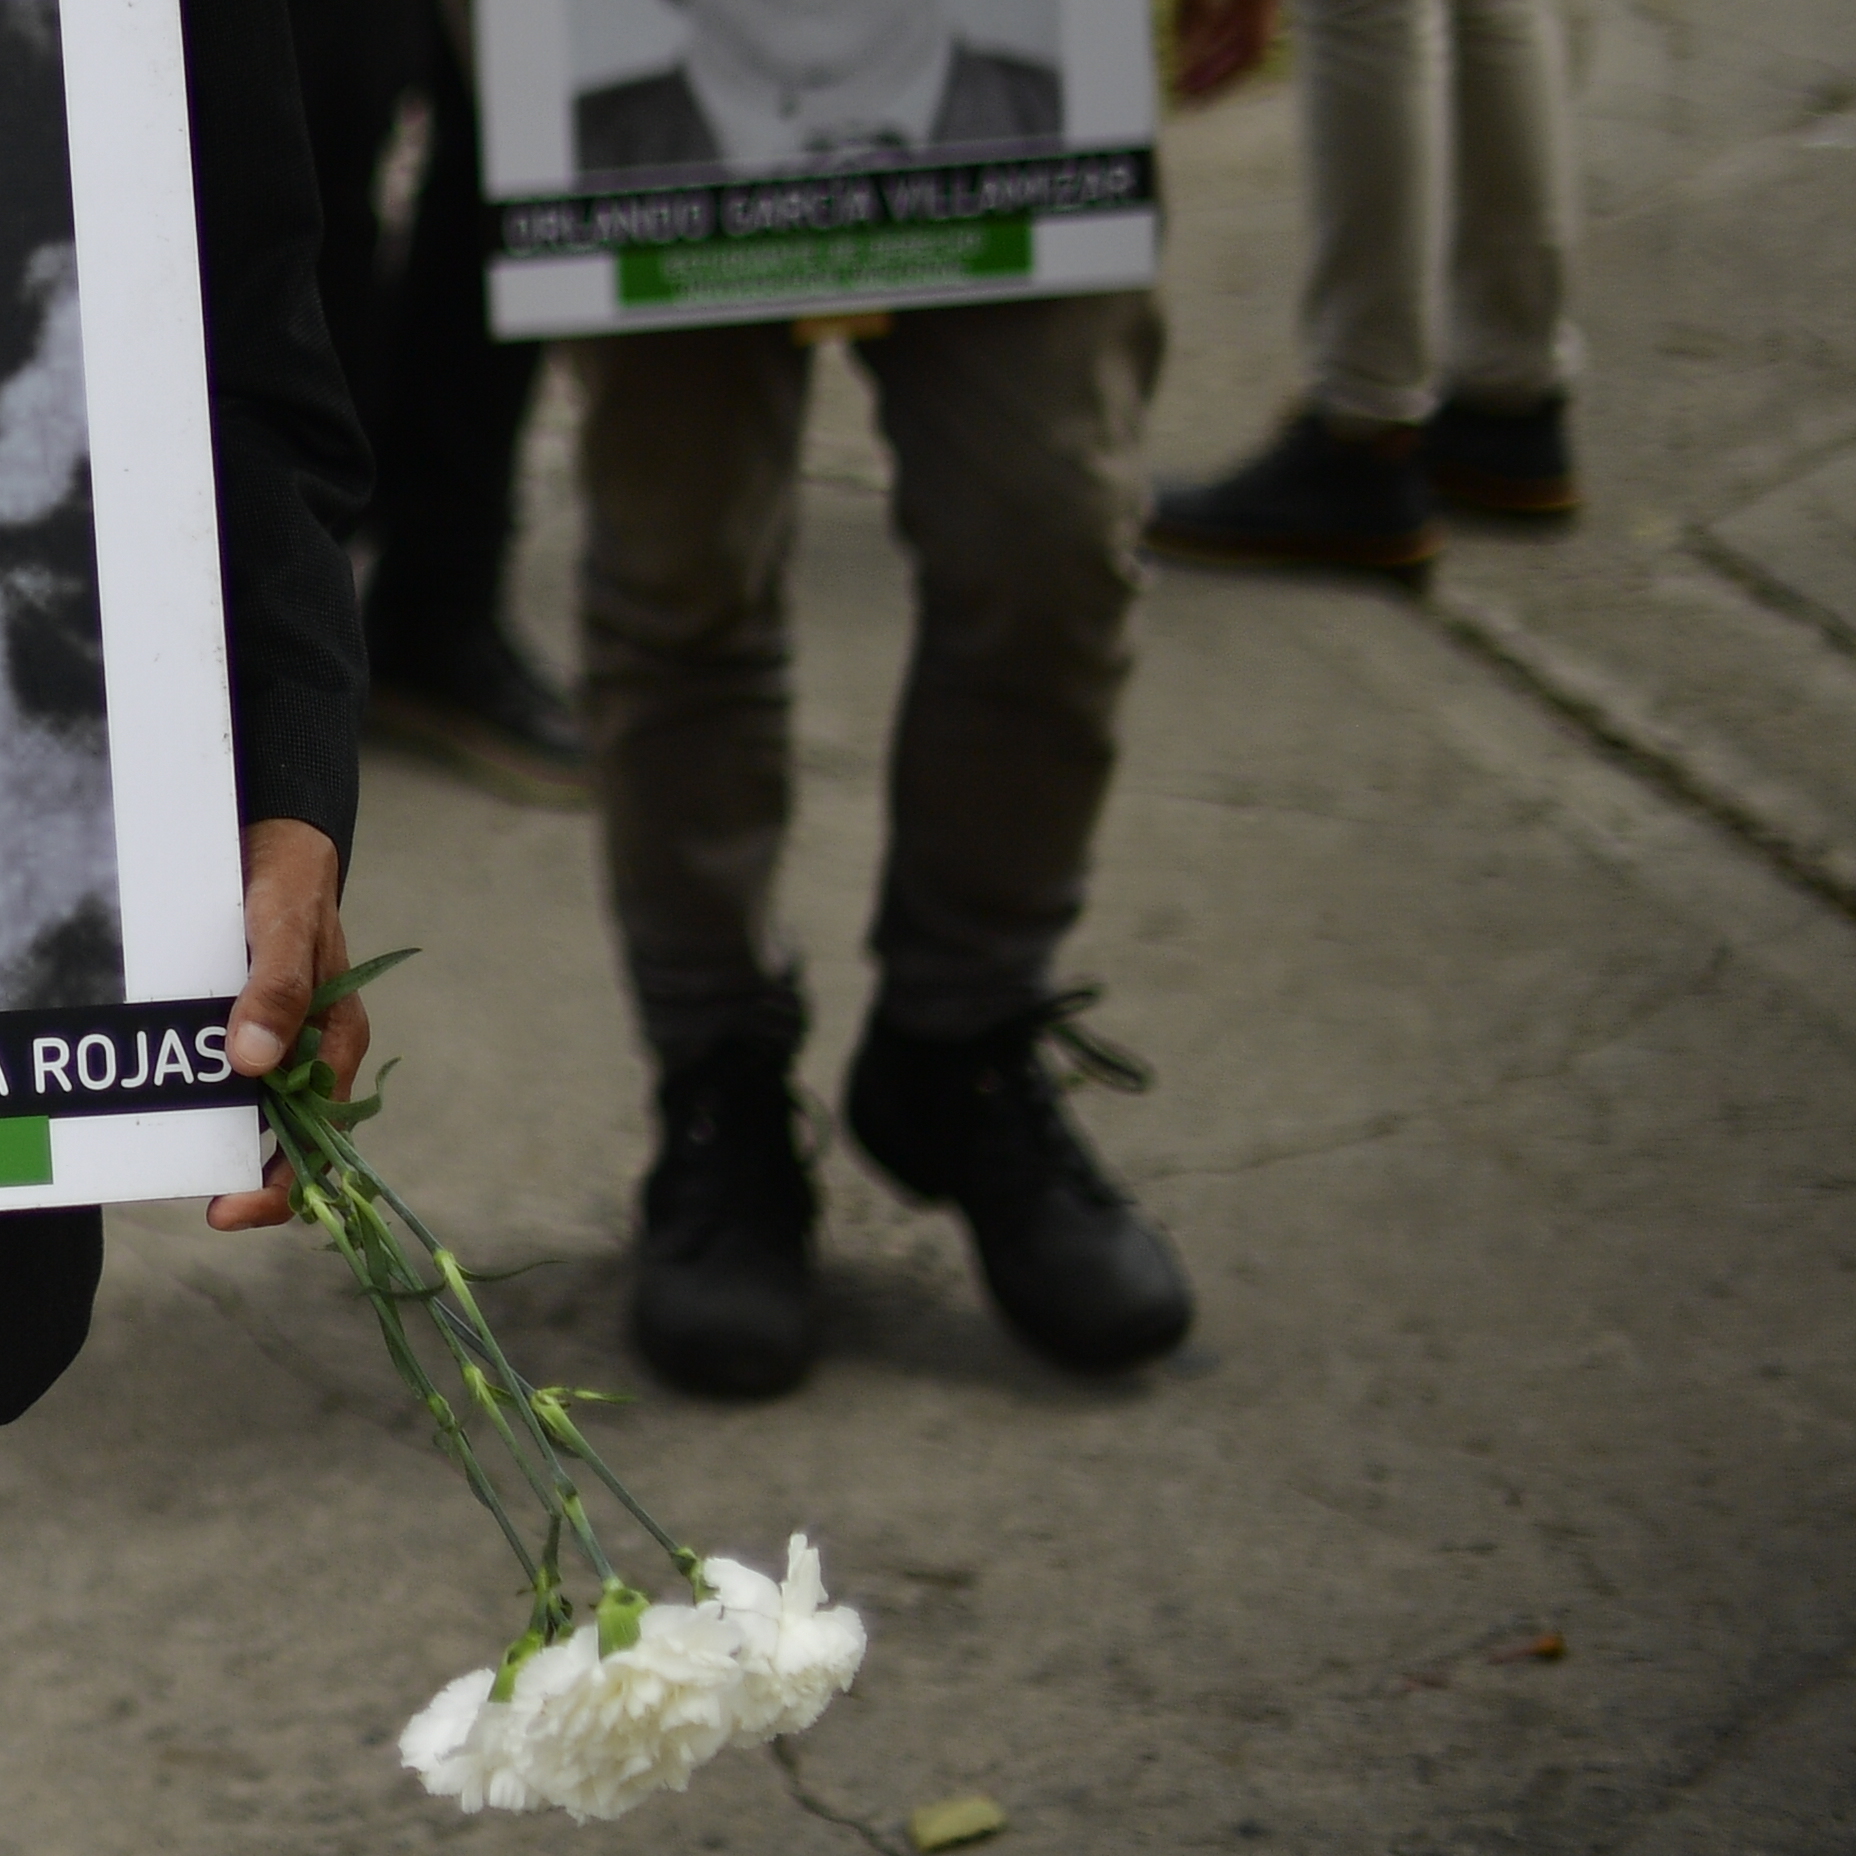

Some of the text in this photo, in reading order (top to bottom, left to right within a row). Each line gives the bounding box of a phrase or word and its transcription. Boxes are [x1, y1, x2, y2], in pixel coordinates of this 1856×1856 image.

[502, 199, 715, 256] ORLANDO
[890, 156, 1133, 220] VILLAMIZAR
[33, 1026, 230, 1094] ROJAS
